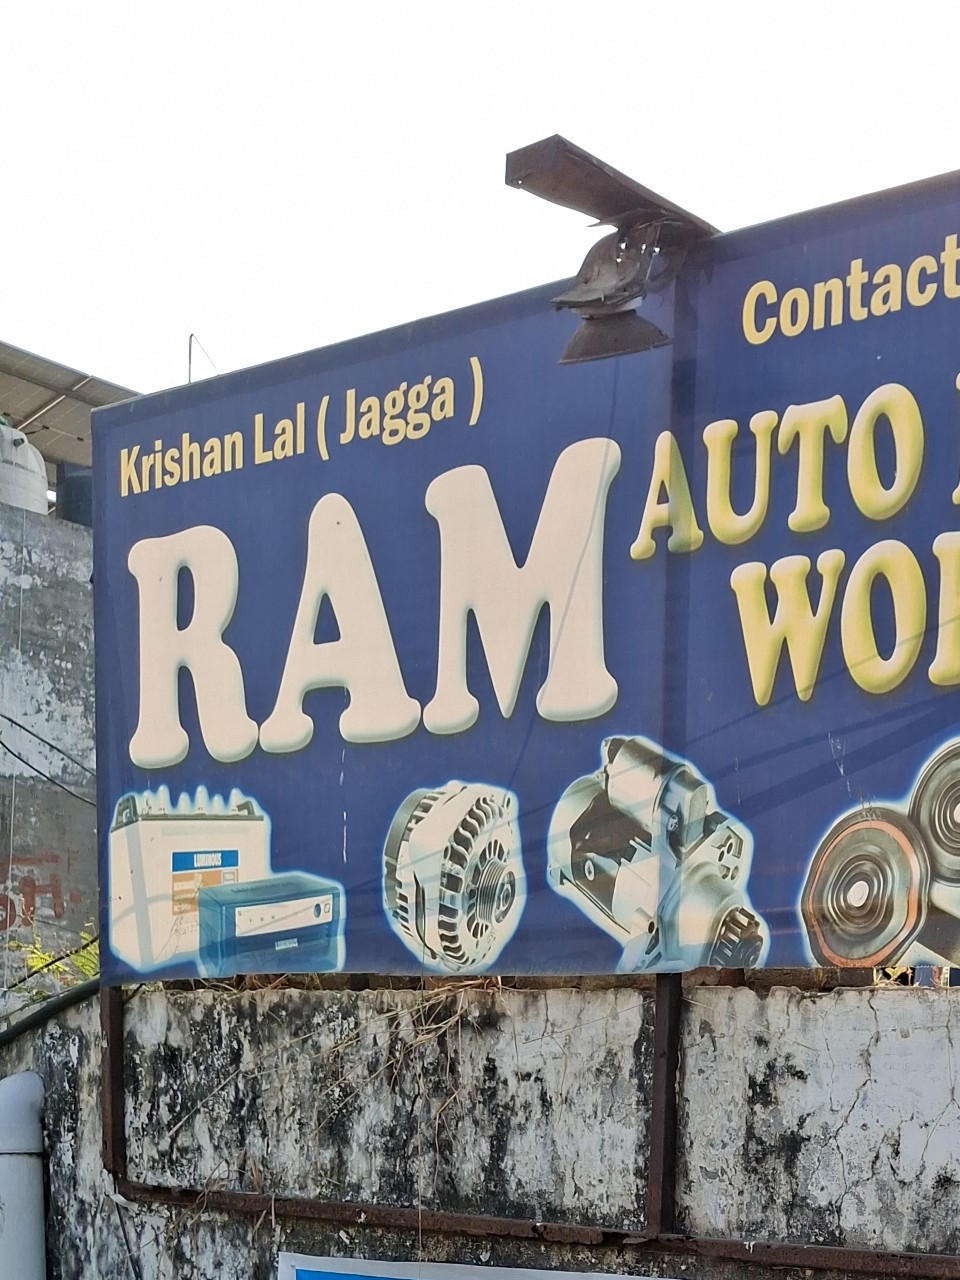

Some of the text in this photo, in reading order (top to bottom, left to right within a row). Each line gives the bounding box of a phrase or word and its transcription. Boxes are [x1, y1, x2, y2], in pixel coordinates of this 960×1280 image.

[119, 429, 244, 497] Krishan
[254, 402, 306, 461] Lal
[340, 375, 454, 447] Jagga
[629, 383, 925, 560] AUTO
[126, 436, 623, 768] RAM
